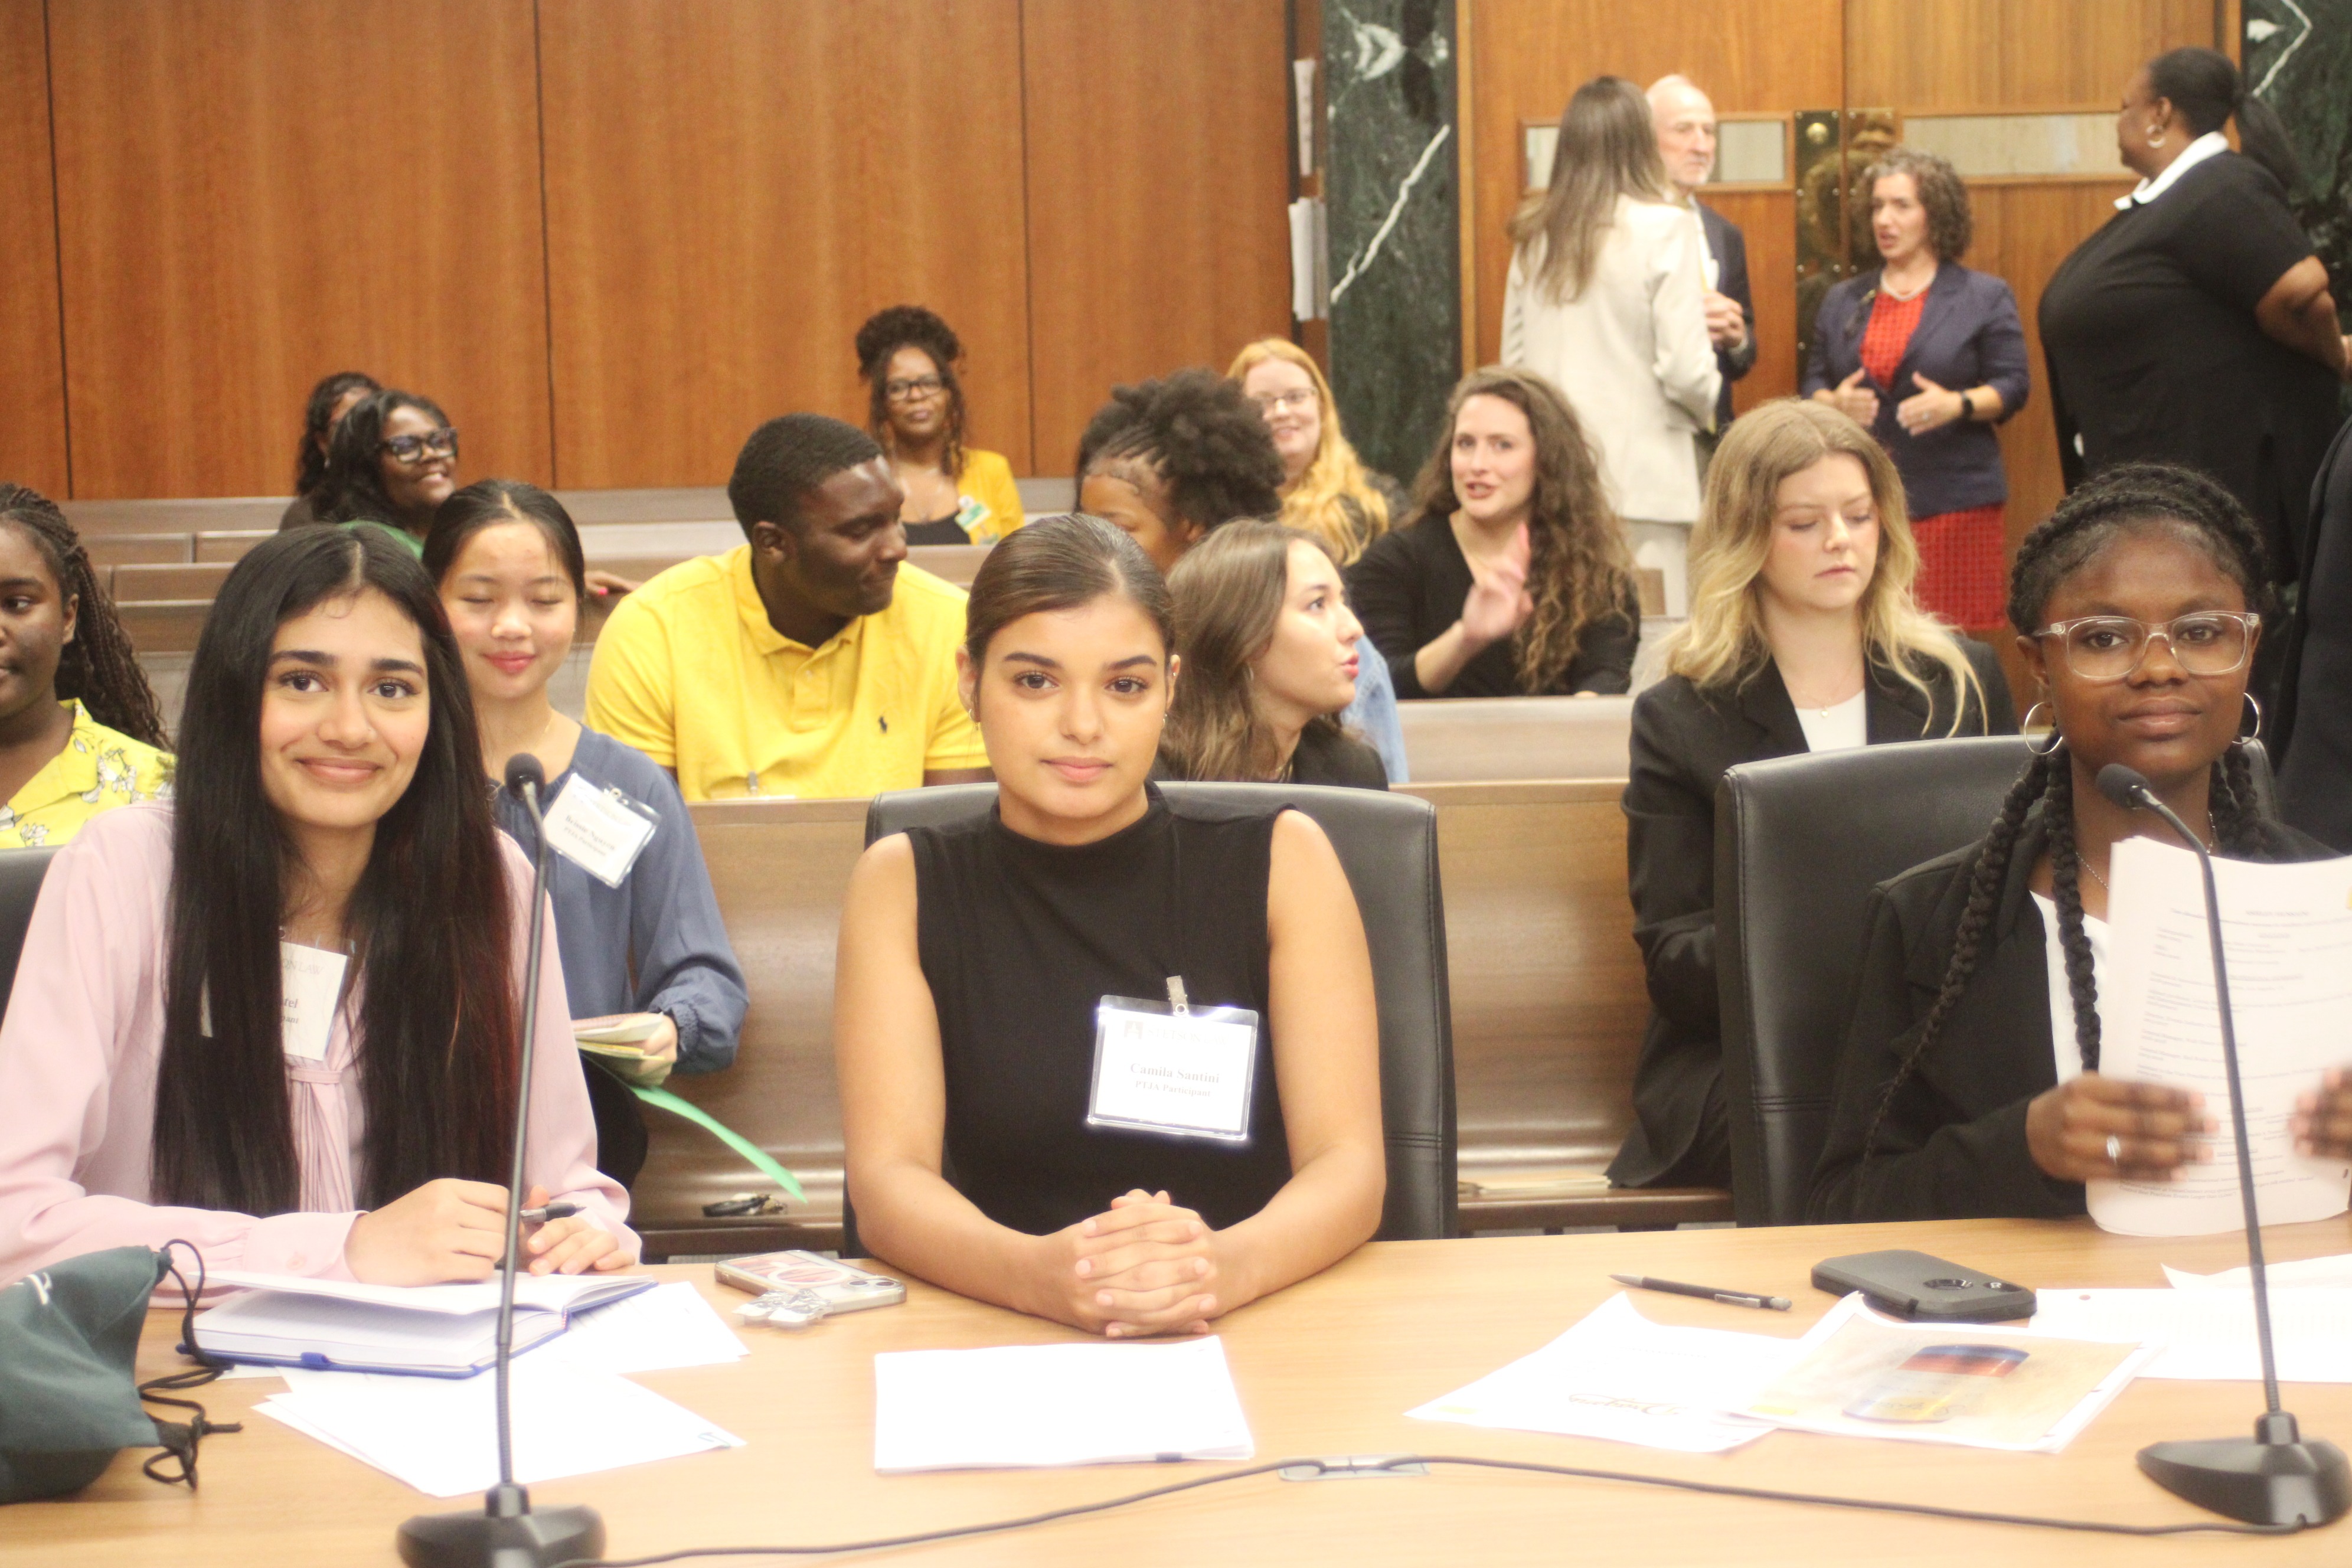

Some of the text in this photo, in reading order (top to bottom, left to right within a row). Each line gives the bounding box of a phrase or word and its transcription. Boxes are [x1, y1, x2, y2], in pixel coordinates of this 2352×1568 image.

[298, 962, 324, 975] LAW
[1148, 1028, 1229, 1046] STETSON LAW
[1130, 1063, 1220, 1084] Camila Santini
[1135, 1080, 1211, 1097] PTJA Participant
